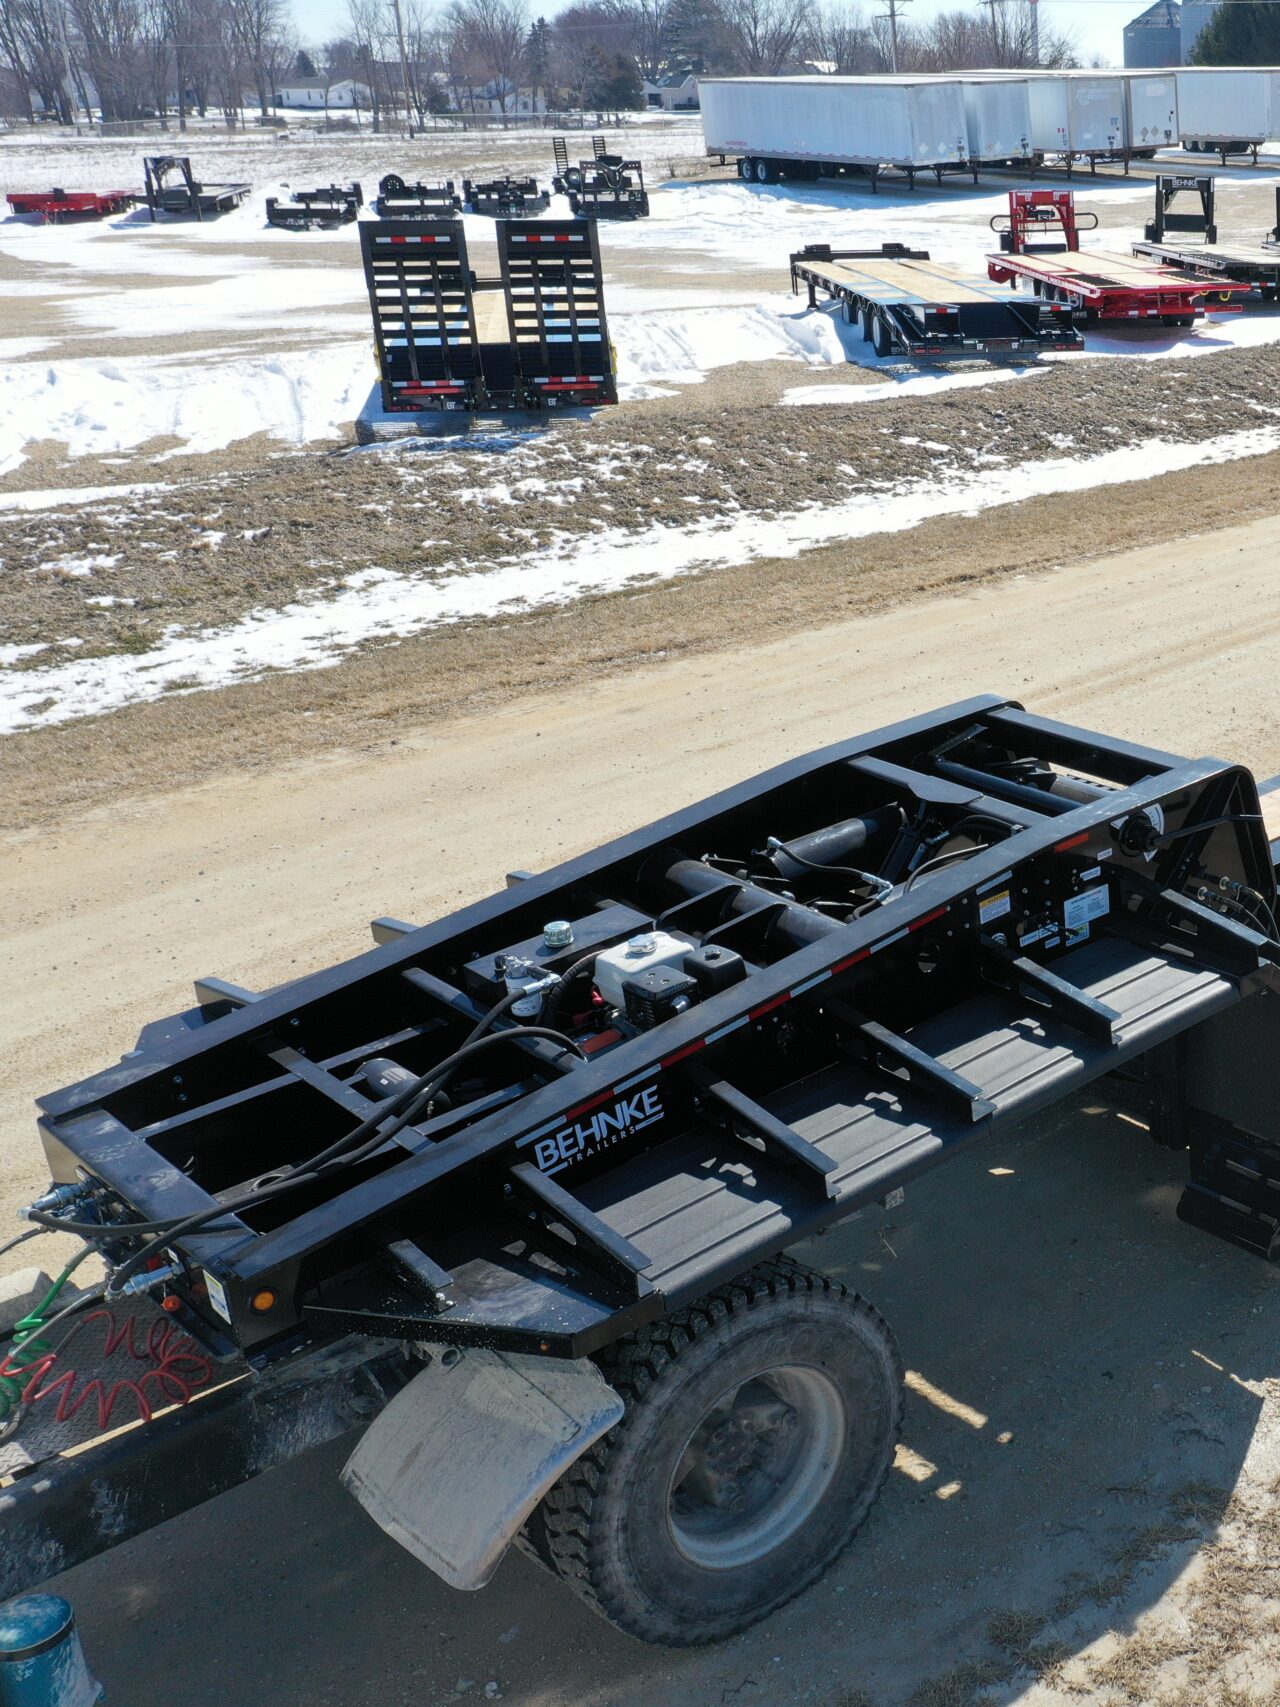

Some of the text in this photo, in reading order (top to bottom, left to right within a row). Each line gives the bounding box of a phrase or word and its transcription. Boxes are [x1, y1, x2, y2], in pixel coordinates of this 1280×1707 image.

[1171, 178, 1199, 187] BEHNKE
[534, 1084, 663, 1170] BEHNKE
[567, 1125, 636, 1166] TRAILERS
